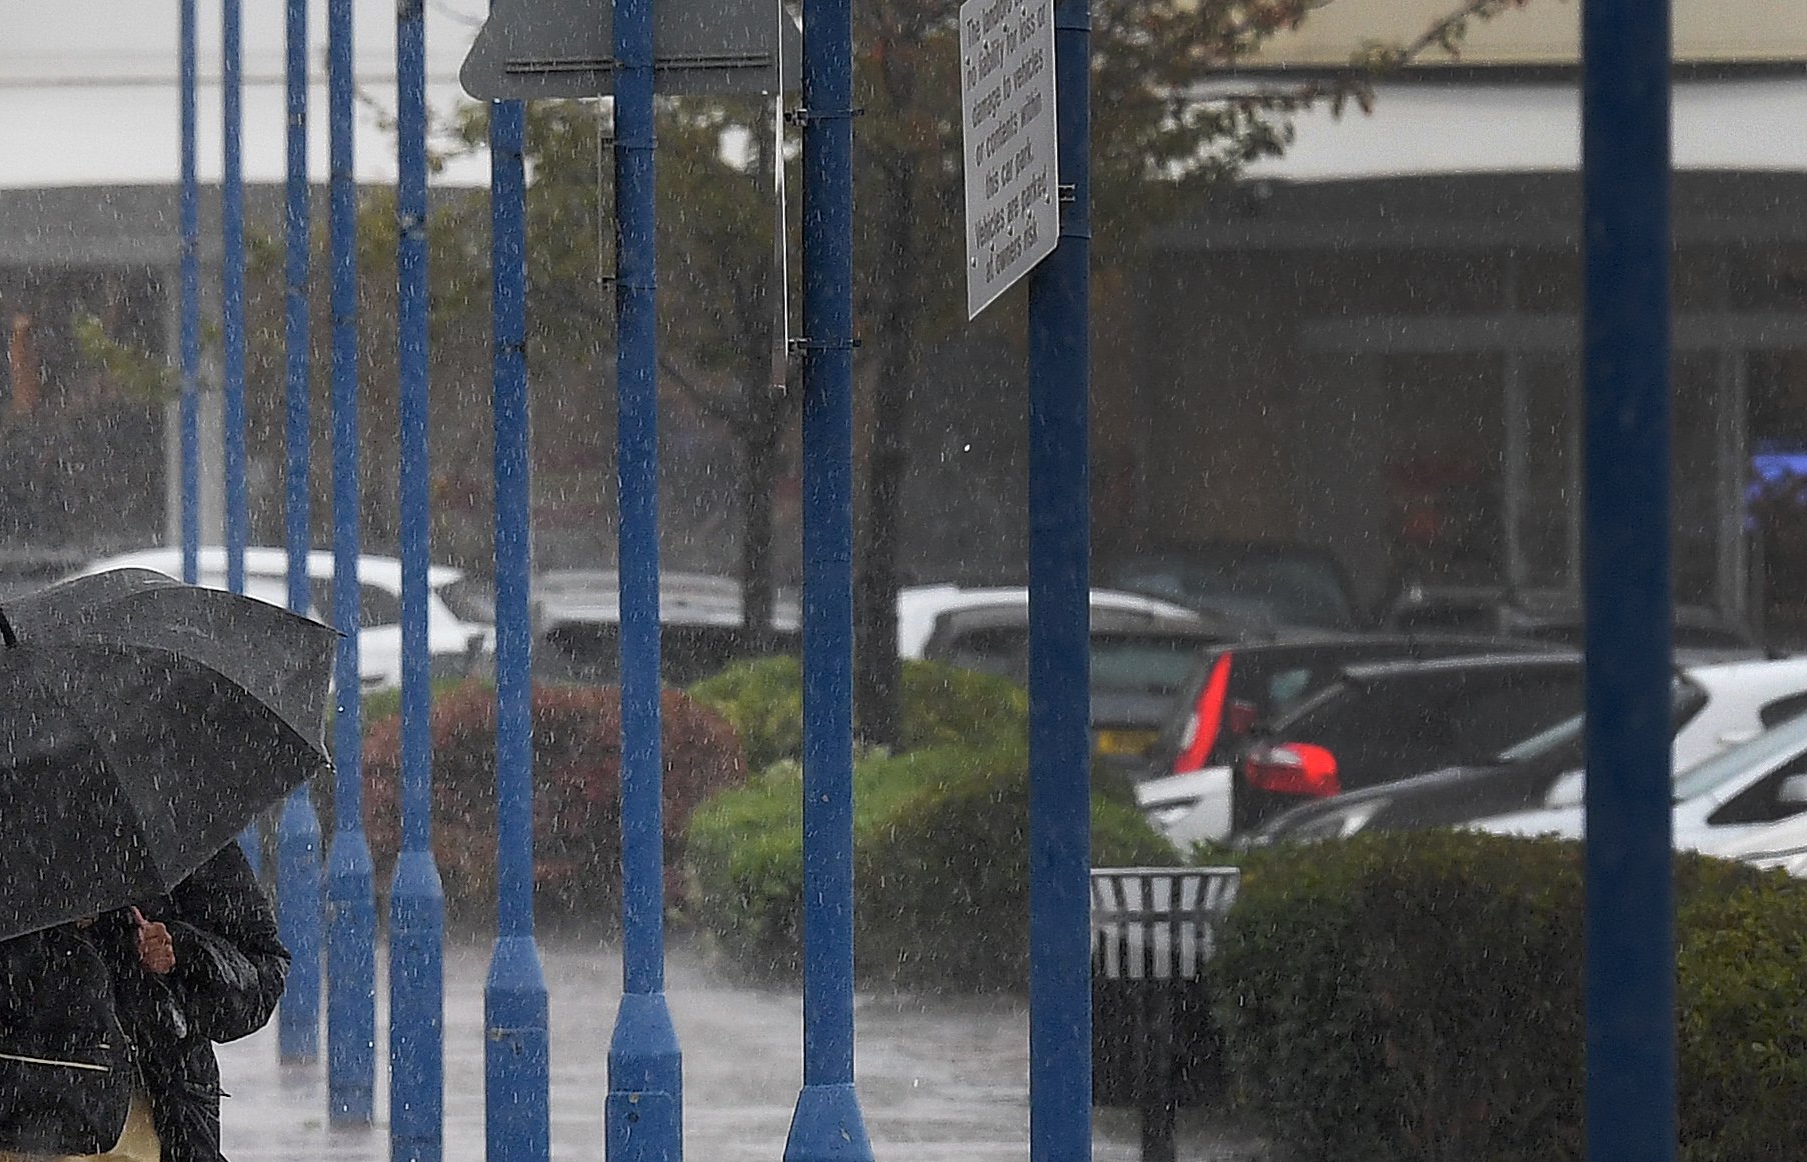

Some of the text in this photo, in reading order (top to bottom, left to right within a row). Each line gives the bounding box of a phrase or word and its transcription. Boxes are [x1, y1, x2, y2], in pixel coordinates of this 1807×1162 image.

[967, 18, 981, 48] The
[967, 3, 1046, 91] no liability for loss or
[972, 47, 1043, 128] damage to vehicles
[976, 142, 984, 167] or
[986, 110, 1018, 157] contents
[975, 164, 1047, 249] Vehicles are parked
[986, 167, 1000, 199] this
[1001, 157, 1013, 187] car
[986, 252, 994, 283] at
[1024, 216, 1038, 250] risk
